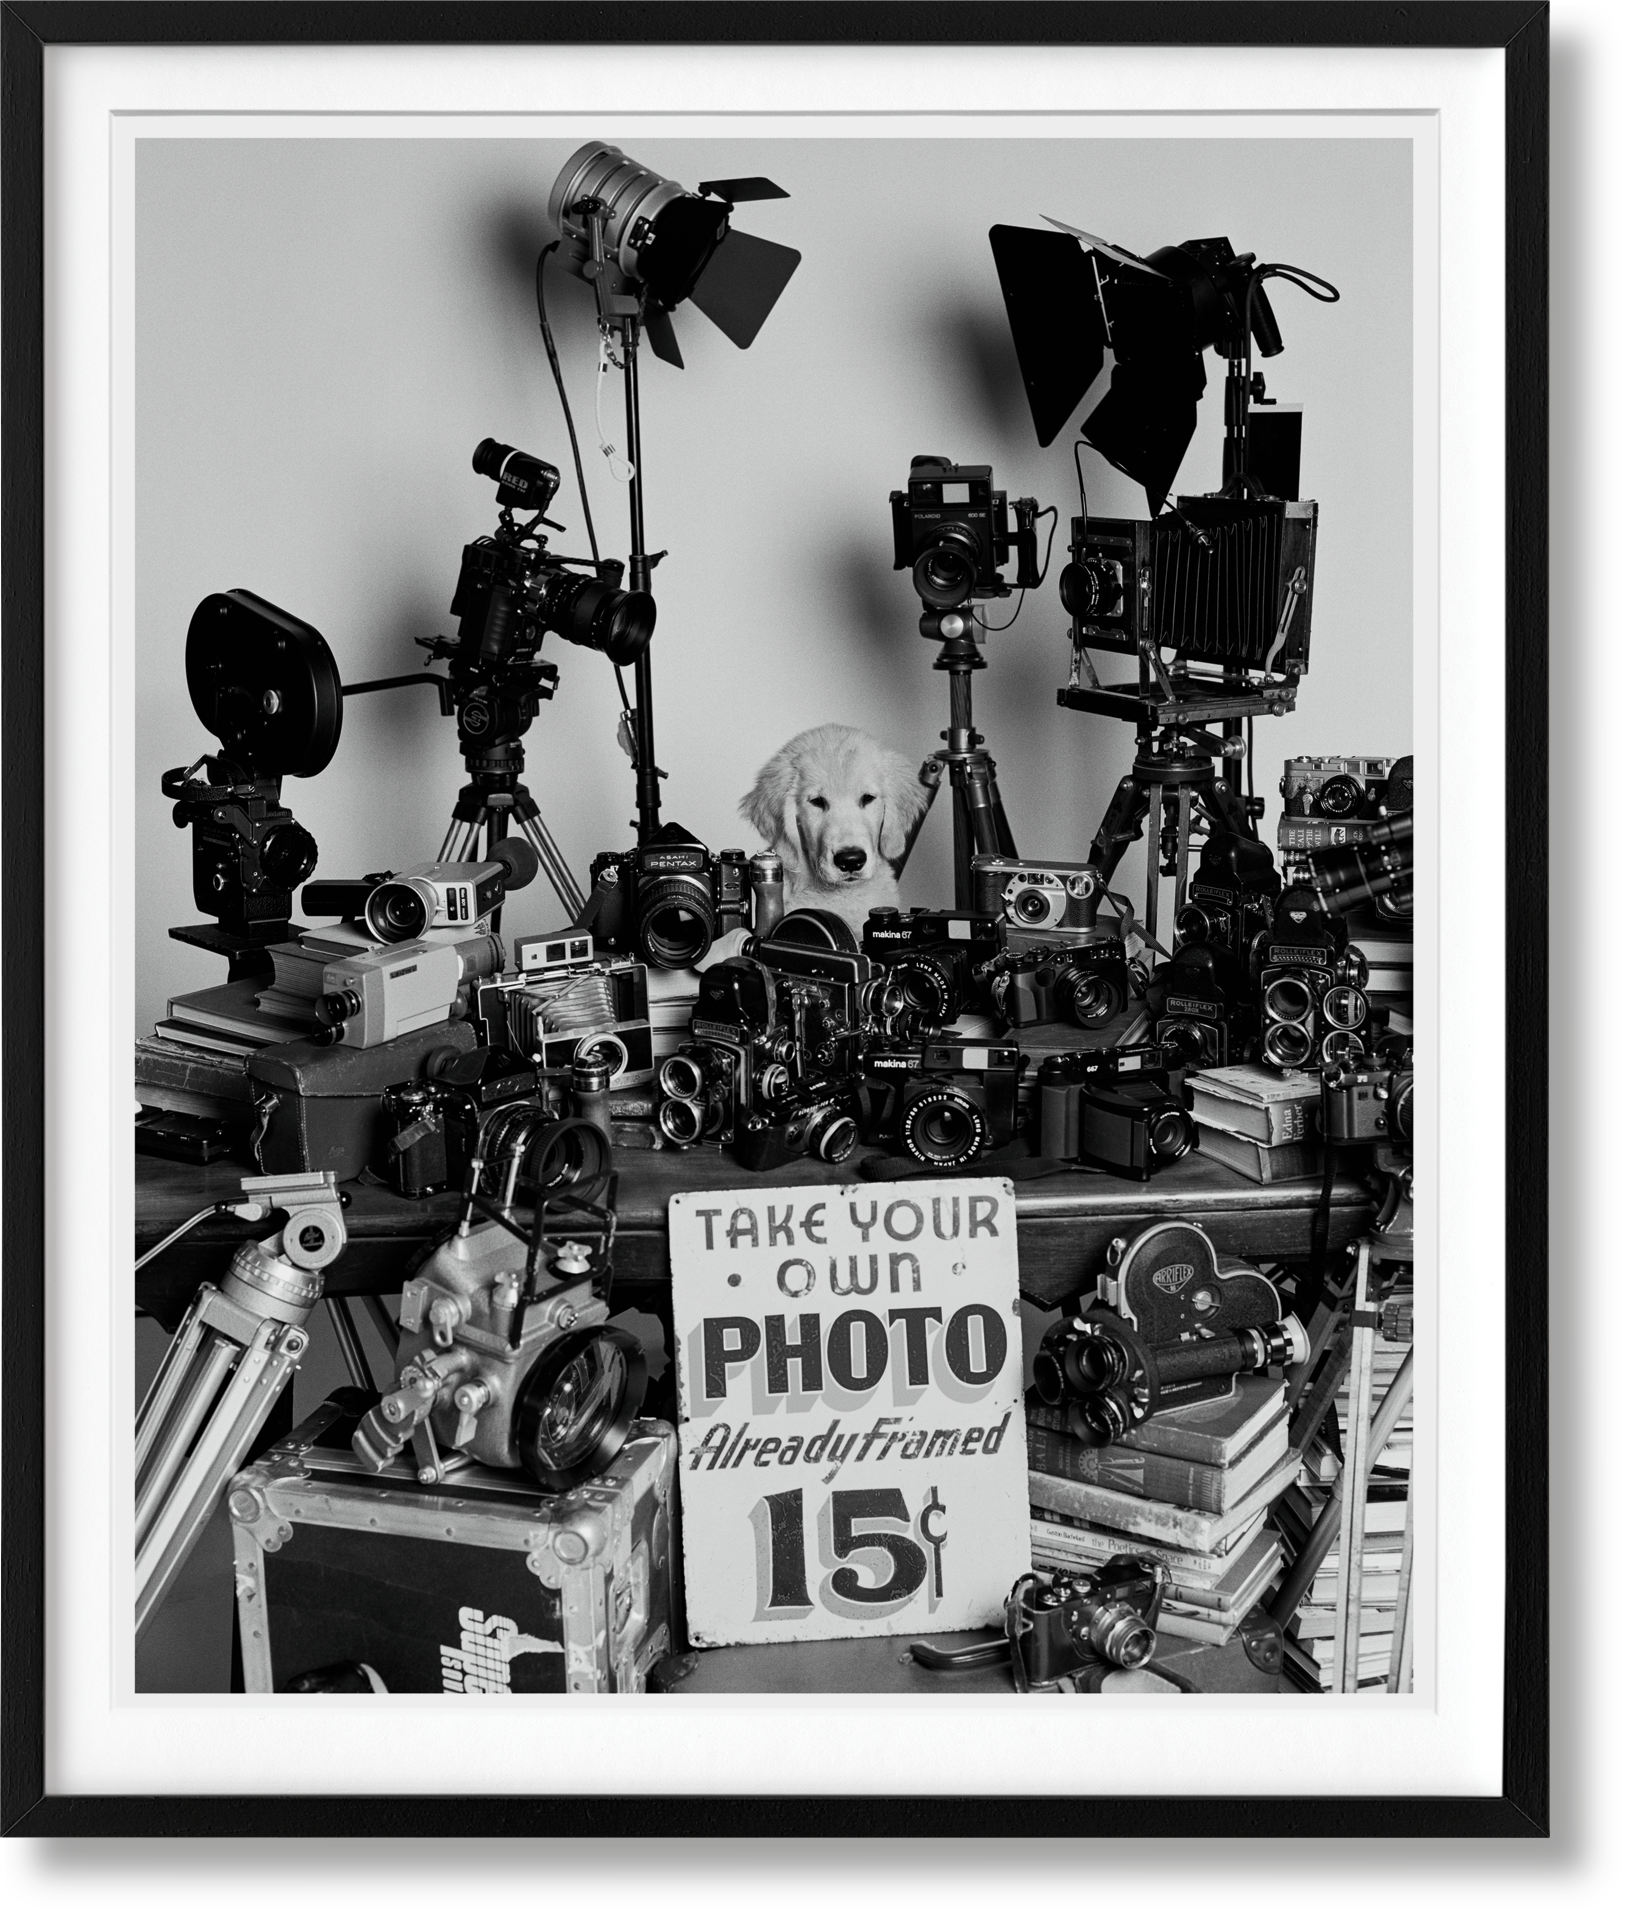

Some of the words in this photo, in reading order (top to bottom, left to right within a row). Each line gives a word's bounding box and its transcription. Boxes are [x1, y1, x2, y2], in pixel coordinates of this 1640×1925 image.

[502, 471, 529, 490] RED
[1195, 886, 1230, 898] ROLLEIFLEX
[872, 930, 901, 939] makina
[901, 930, 912, 939] 67
[1274, 947, 1322, 957] ROLLEIFLEX
[916, 962, 932, 972] LENS
[1170, 1000, 1213, 1012] ROLLEIFLEX
[696, 1022, 737, 1034] ROLLEIFLEX
[874, 1059, 907, 1068] makina
[907, 1060, 919, 1069] 67
[972, 1114, 982, 1133] LENS
[1282, 1109, 1293, 1140] Edna
[1293, 1104, 1304, 1141] Ferber
[906, 1138, 926, 1162] NIKKOR
[967, 1136, 981, 1156] MADE
[695, 1202, 828, 1251] TAKE
[849, 1195, 1000, 1243] YOUR
[776, 1252, 922, 1298] OWN
[1155, 1266, 1193, 1284] ARRIFLEX
[700, 1303, 1009, 1402] PHOTO
[688, 1418, 859, 1485] Already
[854, 1410, 1013, 1463] Framed
[760, 1485, 949, 1609] 15¢
[1091, 1538, 1105, 1548] the
[1108, 1538, 1140, 1554] Poetics
[1155, 1549, 1184, 1565] Space
